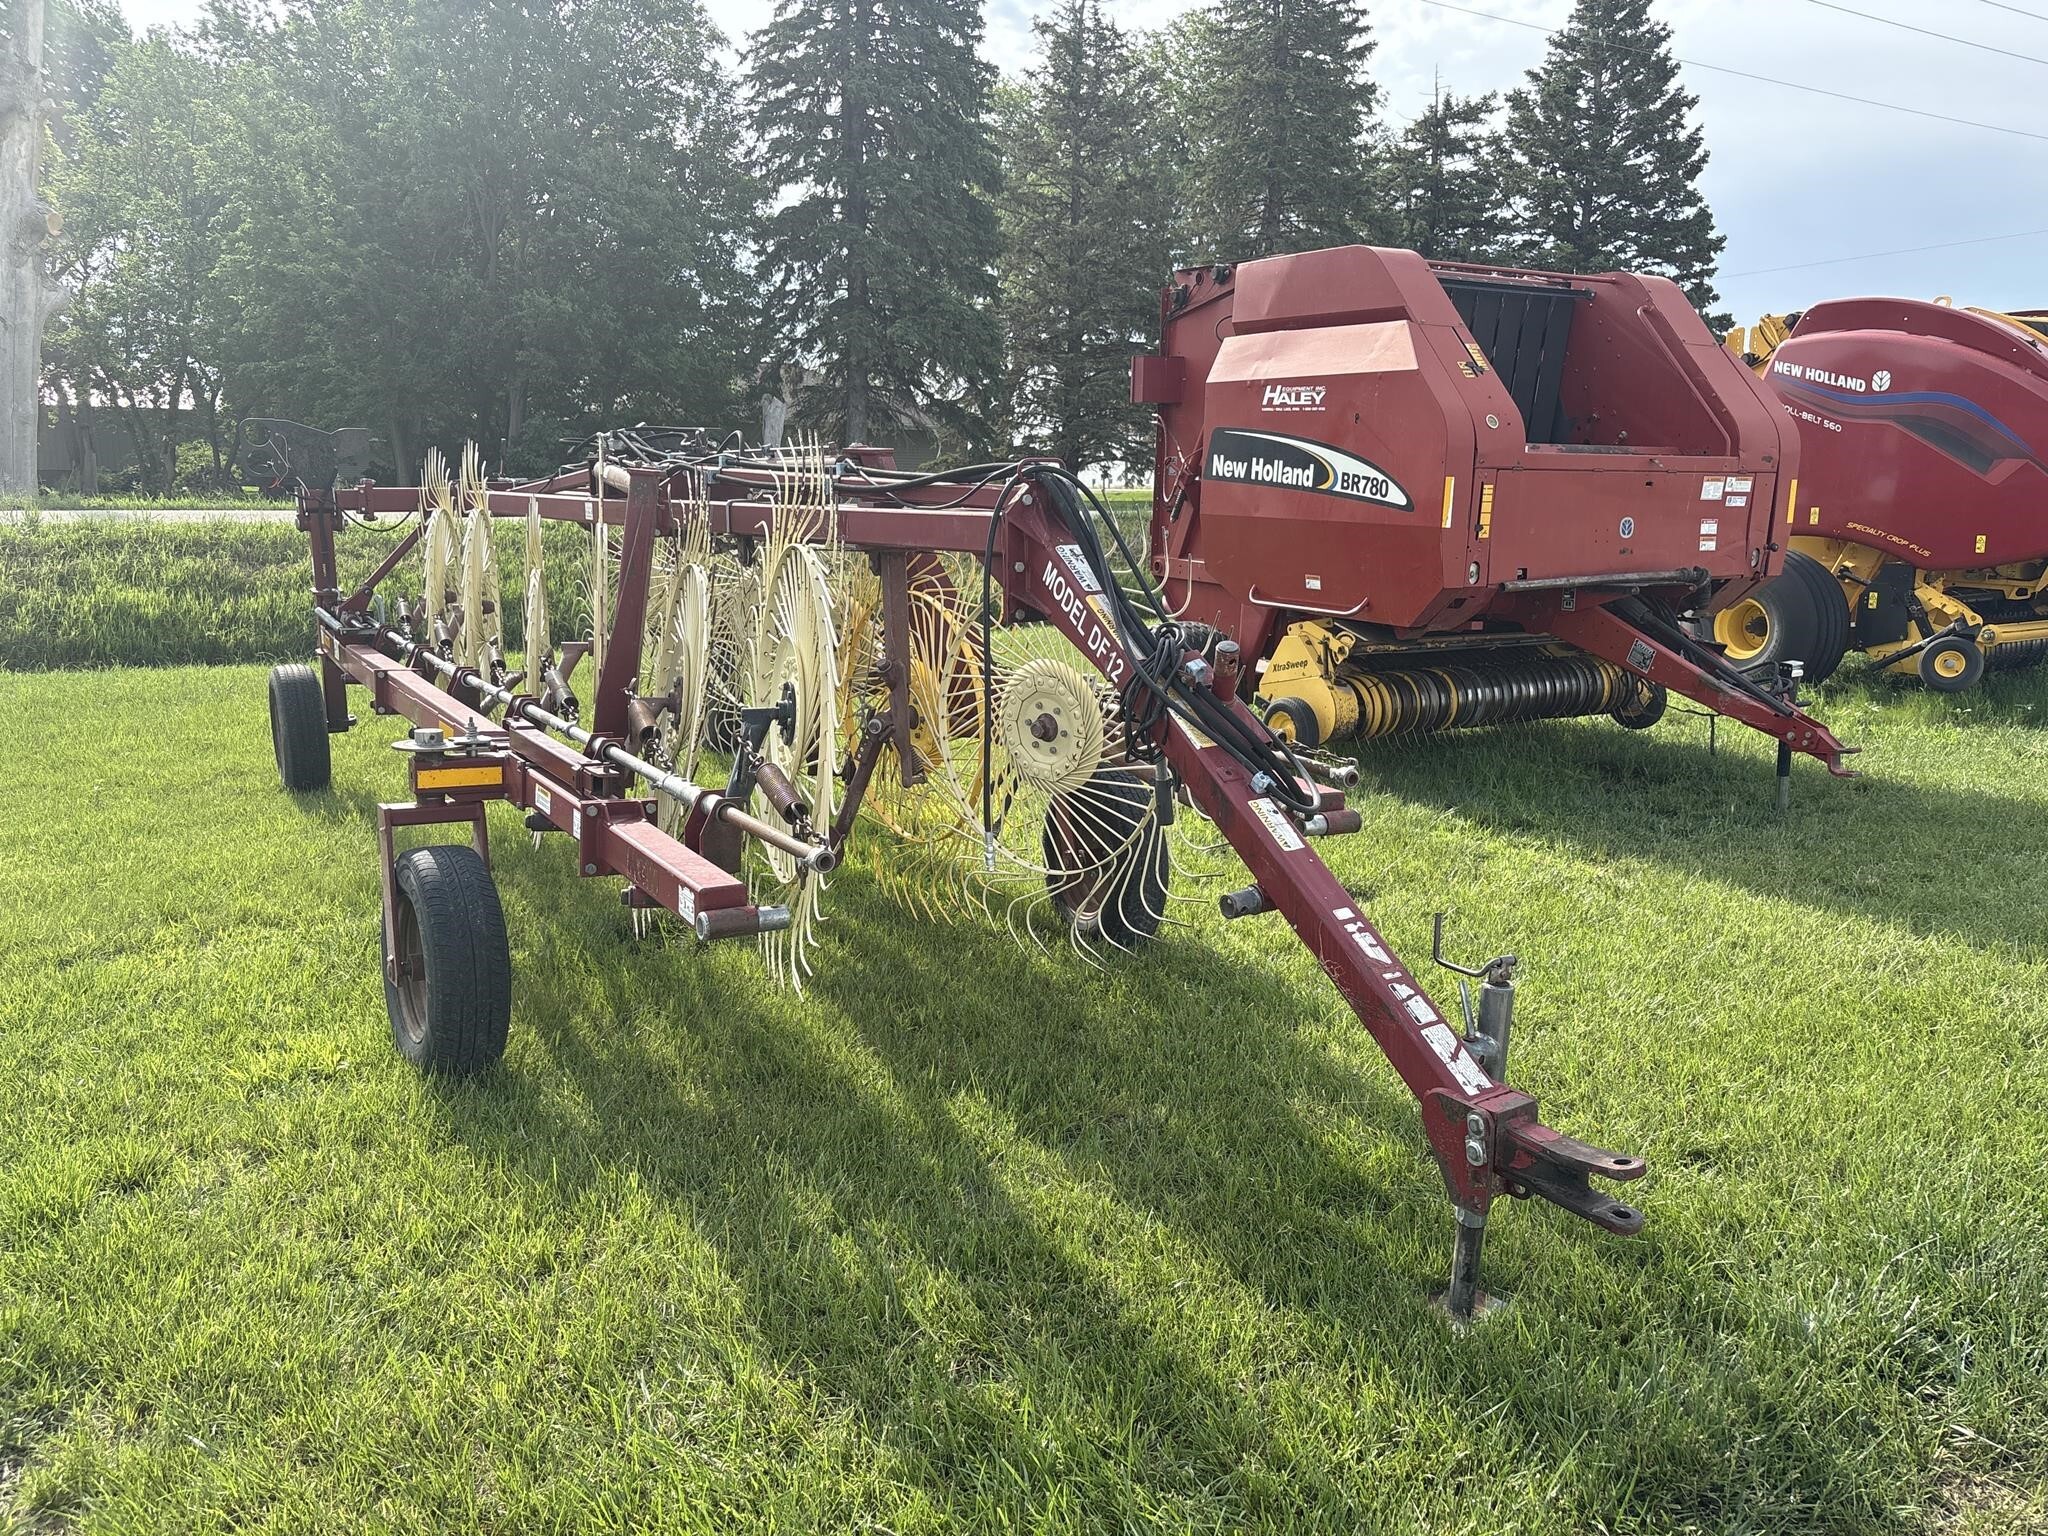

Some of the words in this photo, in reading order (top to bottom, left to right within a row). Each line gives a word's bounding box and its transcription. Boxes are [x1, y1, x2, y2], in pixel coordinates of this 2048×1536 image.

[1774, 361, 1803, 378] NEW
[1805, 367, 1866, 392] HOLLAND
[1262, 385, 1326, 405] HALEY
[1783, 404, 1822, 425] OLL-BELT
[1823, 420, 1842, 433] 560
[1212, 454, 1248, 479] New
[1250, 457, 1315, 488] Holland
[1340, 472, 1389, 498] BR780
[1846, 521, 1888, 538] SPECIALTY
[1886, 534, 1909, 546] CROP
[1909, 543, 1932, 557] PLUS
[1056, 546, 1090, 586] WARNING
[1042, 560, 1088, 637] MODEL
[1272, 659, 1308, 673] XtraSweep
[1250, 801, 1286, 843] WARNING
